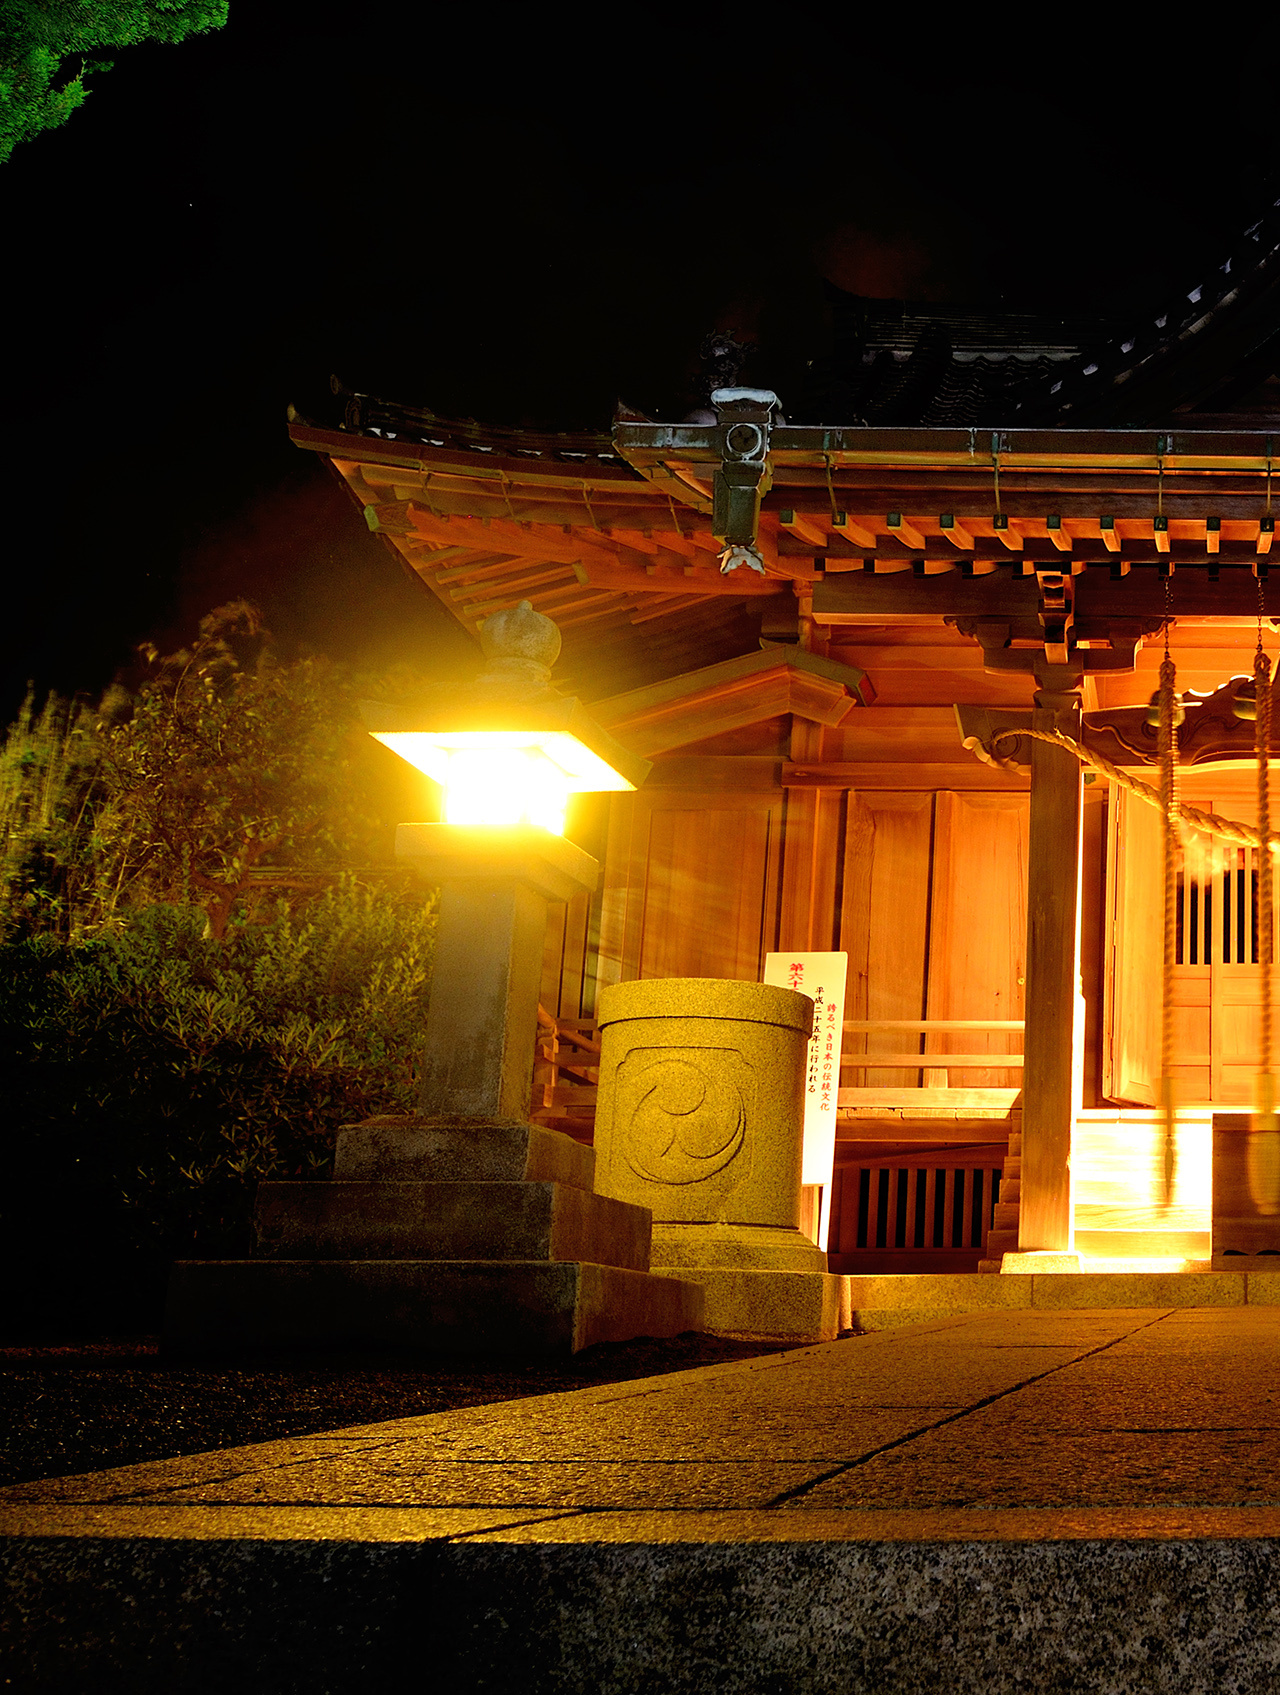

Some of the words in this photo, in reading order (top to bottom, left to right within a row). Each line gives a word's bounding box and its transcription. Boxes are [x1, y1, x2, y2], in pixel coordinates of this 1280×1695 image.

[808, 987, 824, 1093] 平成二十五年に行われる
[820, 1004, 837, 1111] 誇るべき日本の伝統文化
